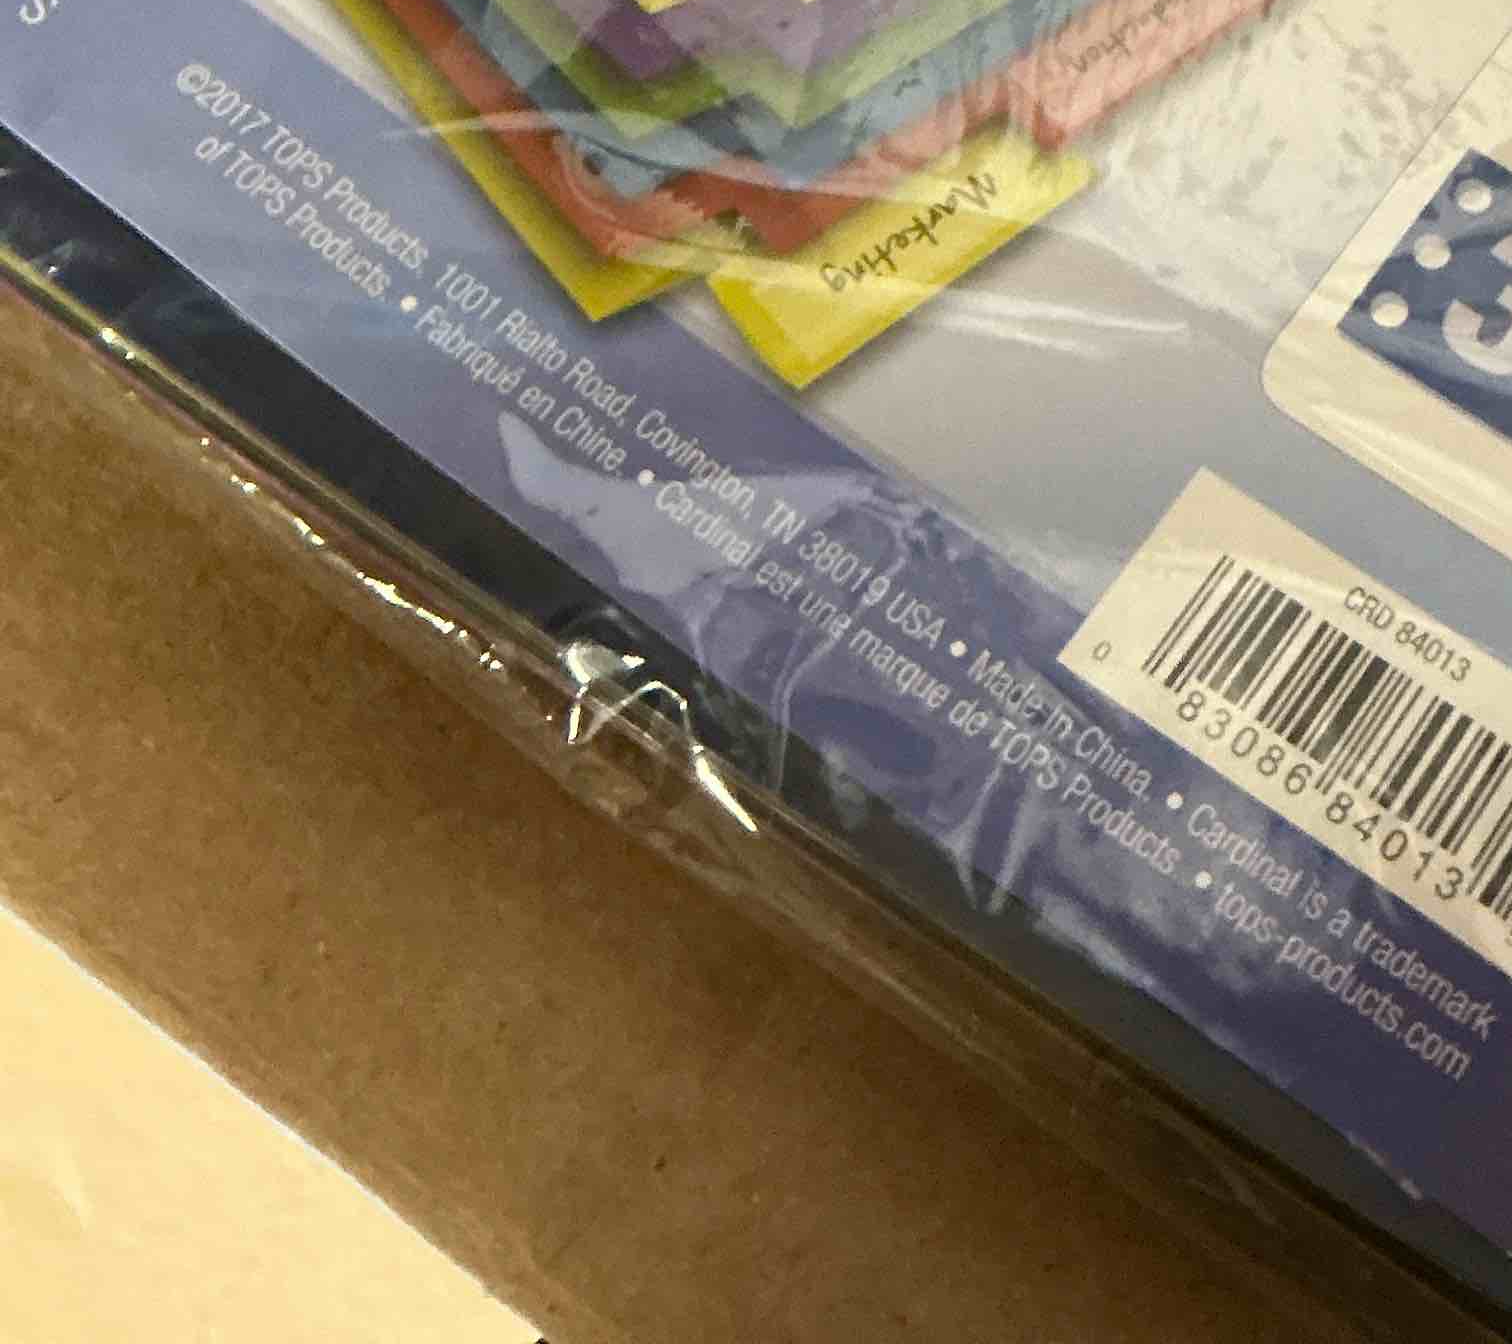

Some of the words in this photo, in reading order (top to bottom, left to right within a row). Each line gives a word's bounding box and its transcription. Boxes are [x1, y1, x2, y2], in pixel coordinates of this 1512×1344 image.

[820, 173, 997, 292] Marketing
[176, 62, 272, 153] ©2017
[264, 124, 334, 192] TOPS
[435, 263, 503, 322] 1001
[496, 309, 567, 373] Rialto
[762, 499, 804, 543] TN
[797, 528, 891, 607] 38019
[881, 588, 947, 649] USA
[966, 648, 1042, 722] Made
[1049, 706, 1074, 742] in
[1186, 802, 1303, 900] Cardinal
[1301, 880, 1326, 920] is
[1326, 908, 1348, 937] a
[1353, 920, 1498, 1042] trademark
[194, 134, 227, 162] of
[222, 146, 293, 218] TOPS
[413, 305, 526, 396] Fabriqué
[518, 384, 557, 421] en
[653, 478, 760, 572] Cardinal
[756, 559, 800, 603] est
[800, 592, 851, 643] une
[850, 621, 955, 712] marque
[950, 690, 989, 738] de
[987, 715, 1060, 794] TOPS
[1213, 880, 1471, 1080] tops-products.com
[1342, 585, 1394, 631] CRD
[1395, 622, 1473, 682] 84013
[1090, 641, 1112, 663] 0
[1178, 691, 1314, 797] 83086
[1325, 789, 1466, 903] 84013
